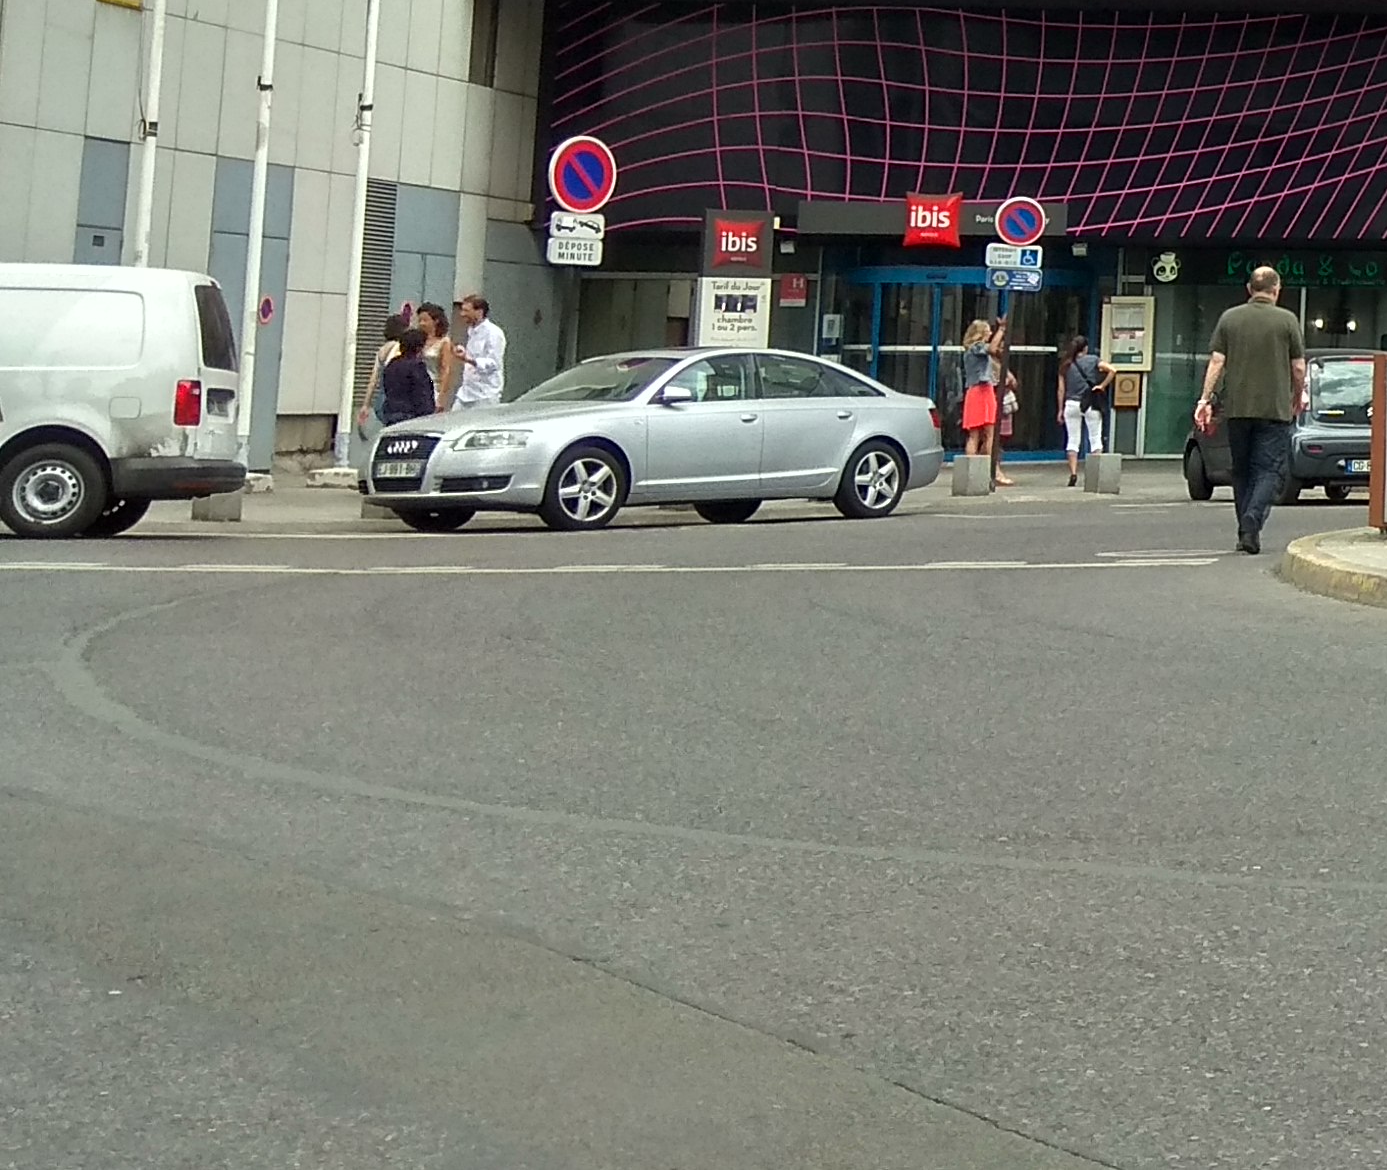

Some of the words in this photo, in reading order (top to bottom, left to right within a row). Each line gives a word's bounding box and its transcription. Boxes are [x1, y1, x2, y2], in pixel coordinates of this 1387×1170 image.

[910, 205, 950, 228] ibis
[975, 214, 993, 223] Paris
[558, 241, 594, 252] DÉPOSE
[721, 232, 758, 252] ibis
[557, 252, 593, 261] MINUTE
[711, 280, 729, 290] Tarif
[731, 280, 741, 290] du
[743, 281, 761, 291] Jour
[717, 314, 753, 323] chambre
[736, 325, 757, 333] pers.
